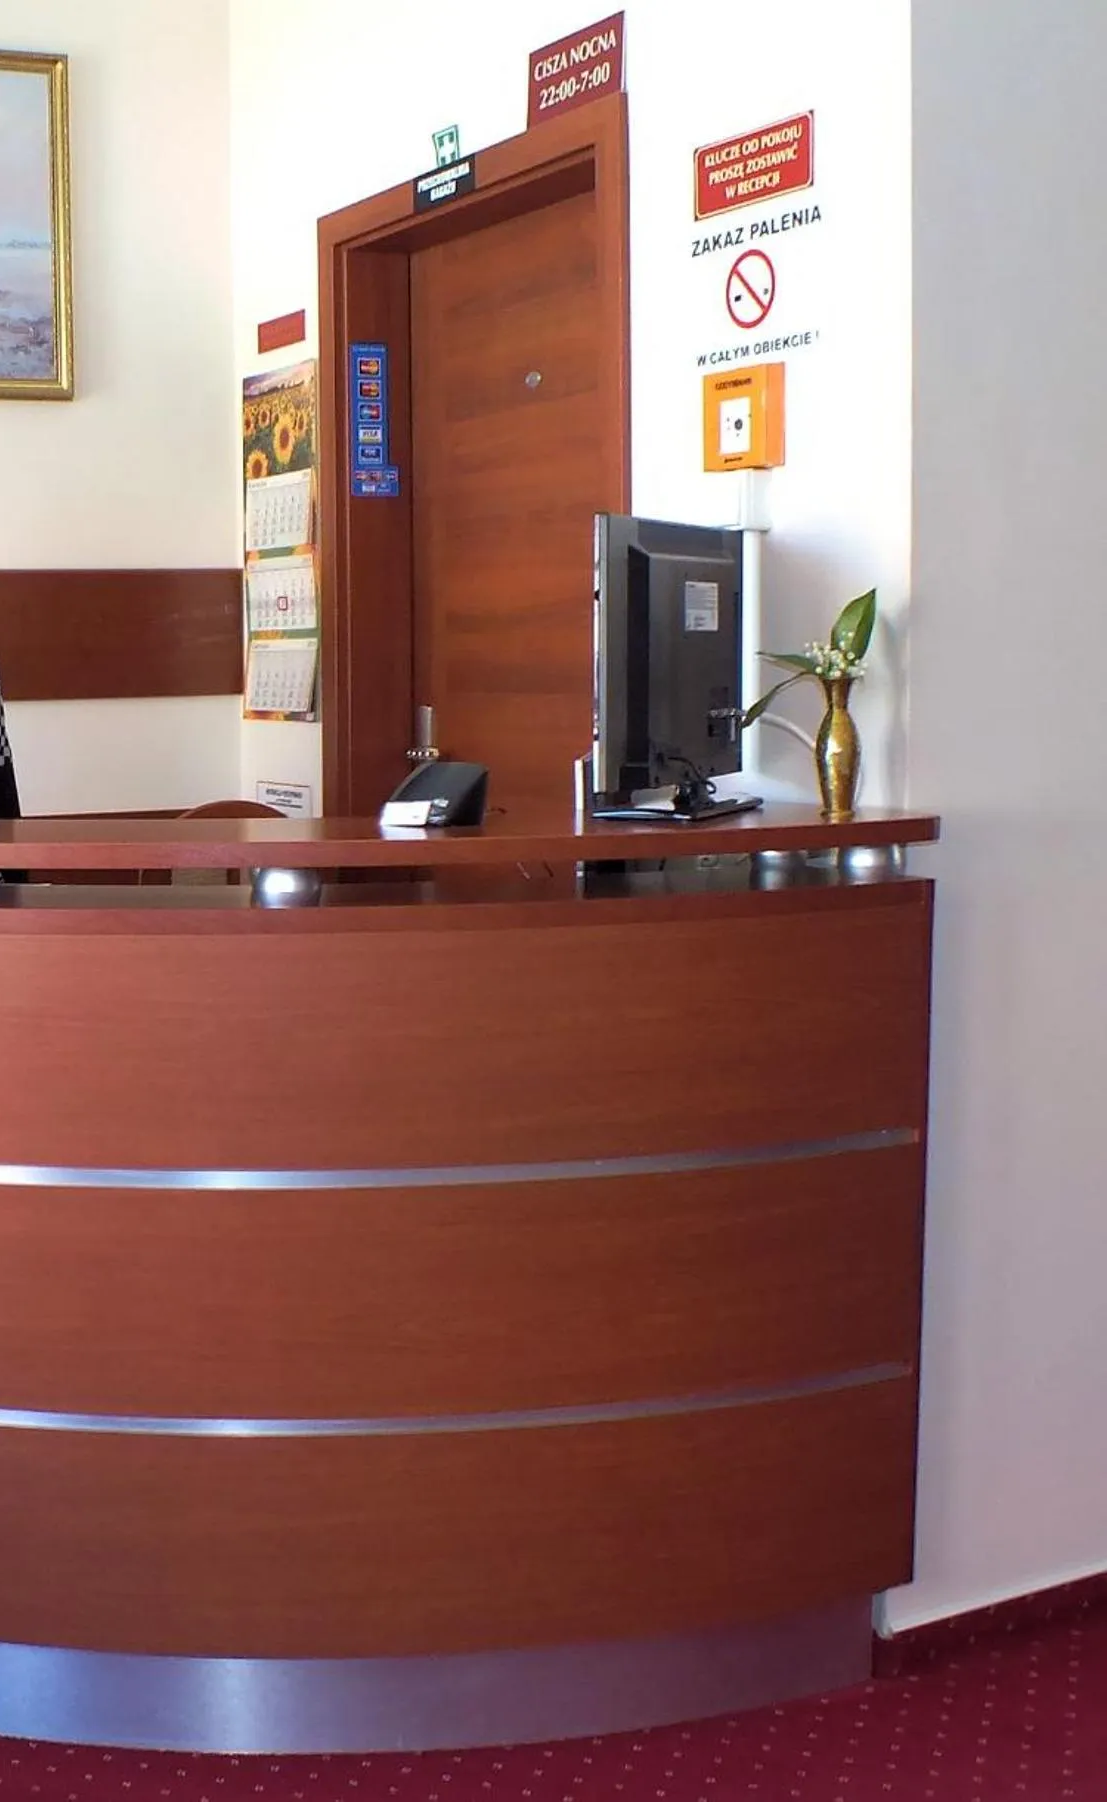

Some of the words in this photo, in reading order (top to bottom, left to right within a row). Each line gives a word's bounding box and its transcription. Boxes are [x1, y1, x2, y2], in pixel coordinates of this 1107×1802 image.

[534, 52, 568, 82] CISZA
[570, 29, 616, 66] NOCNA
[539, 62, 610, 110] 22:00-7:00
[705, 143, 741, 168] KLUCZE
[742, 138, 759, 155] OD
[761, 123, 802, 149] POKOJU
[709, 162, 745, 187] PROSZĘ
[725, 184, 737, 199] W
[691, 227, 745, 258] ZAKAZ
[750, 205, 822, 240] PALENIA
[696, 355, 707, 367] W
[753, 331, 812, 355] OBIEKCIE
